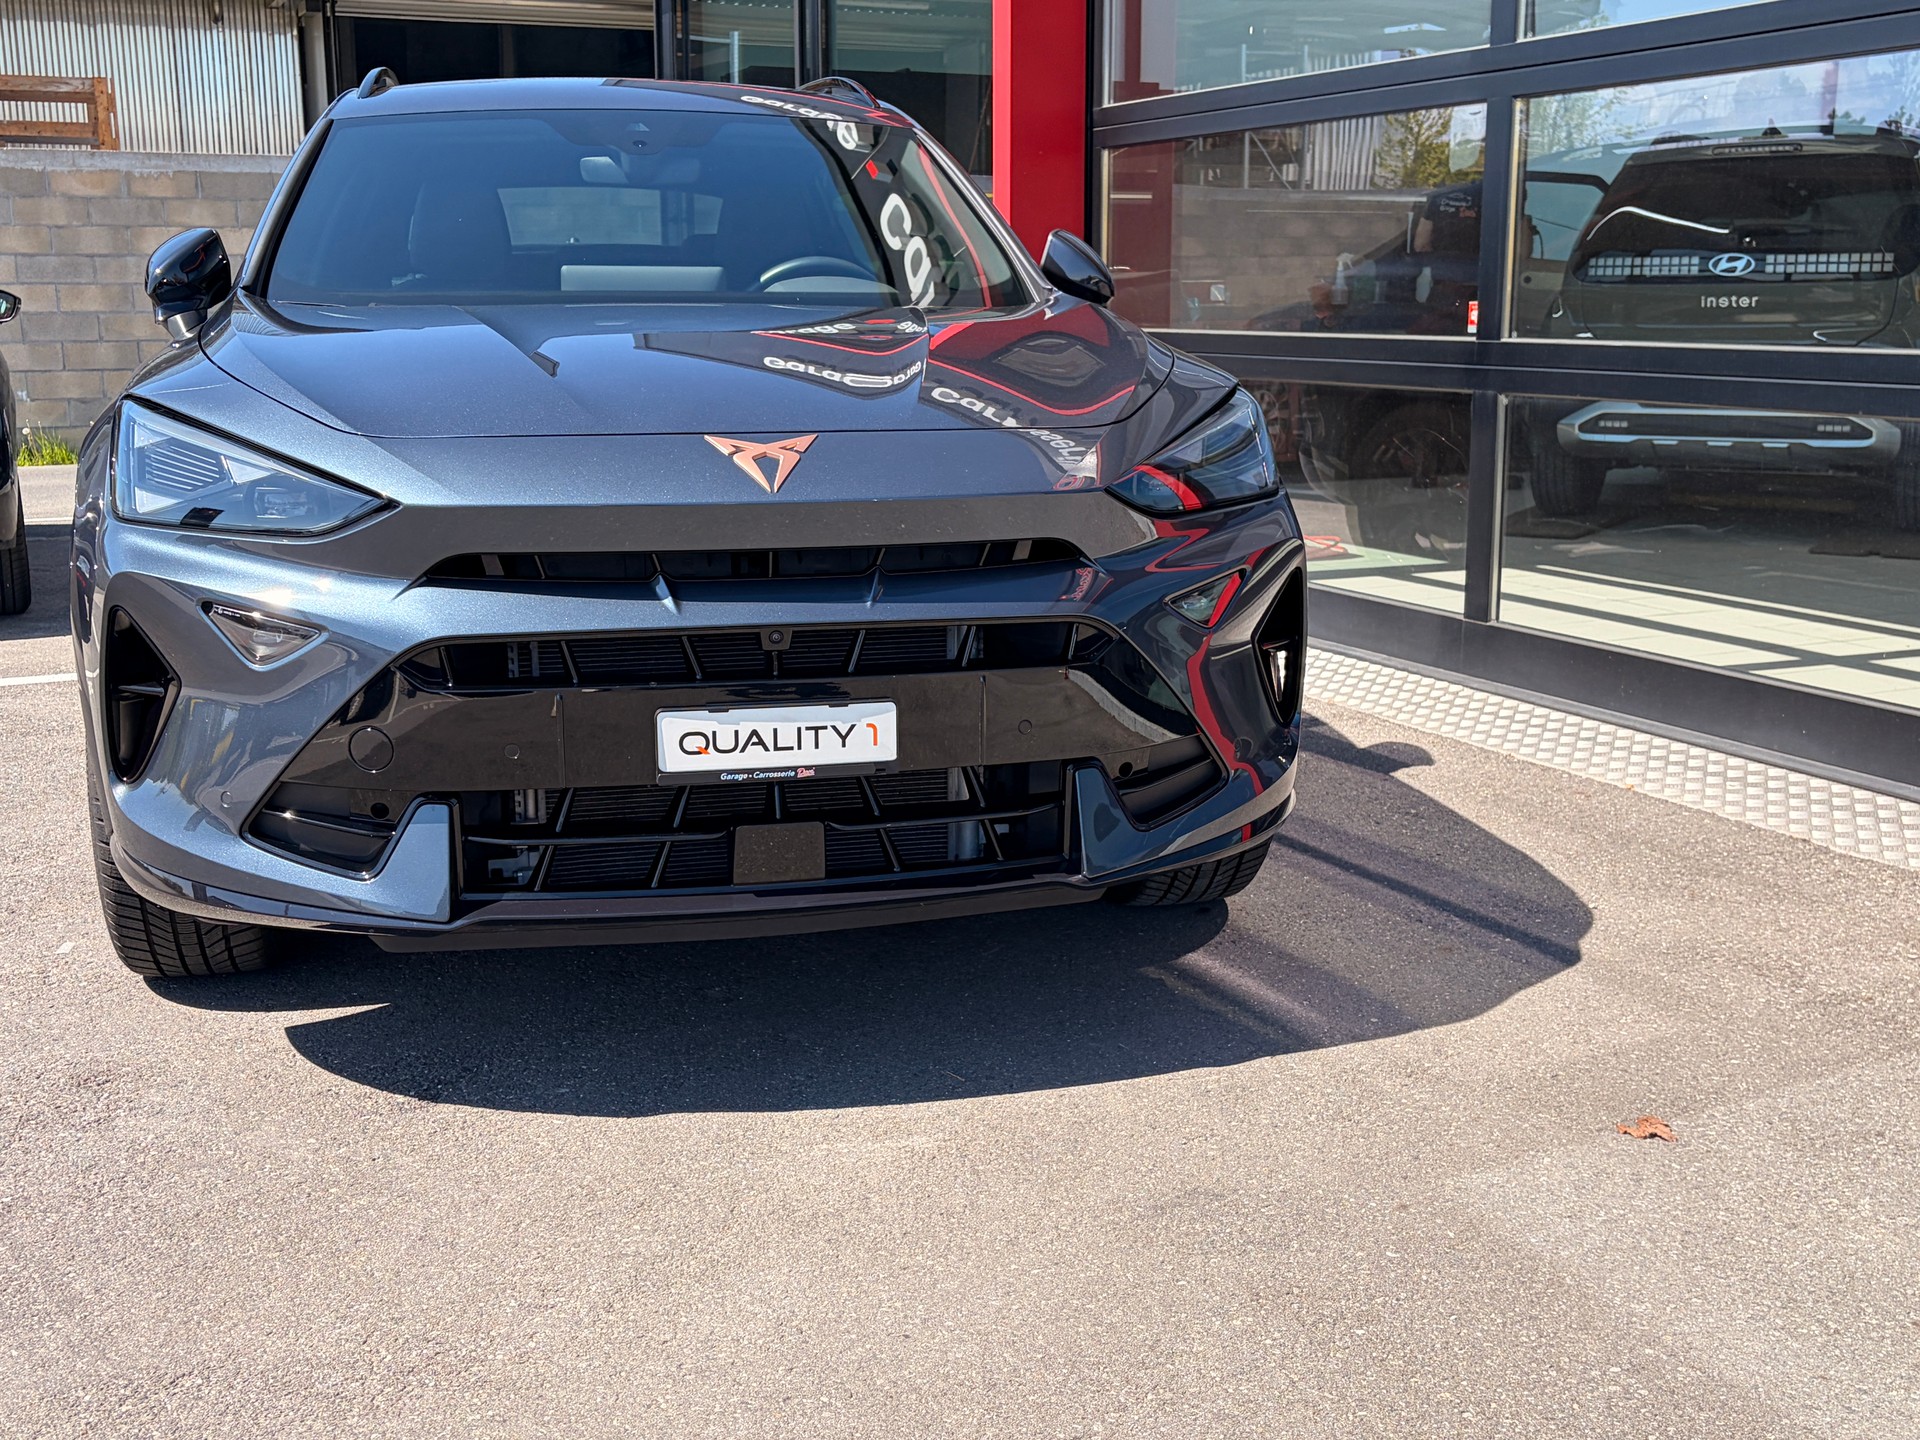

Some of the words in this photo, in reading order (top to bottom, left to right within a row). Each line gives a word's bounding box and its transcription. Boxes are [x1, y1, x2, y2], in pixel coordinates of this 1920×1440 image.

[1700, 295, 1760, 308] inster
[678, 723, 857, 756] QUALITY
[865, 722, 879, 747] 1
[720, 772, 748, 781] Garage
[753, 769, 796, 779] Carrosserie
